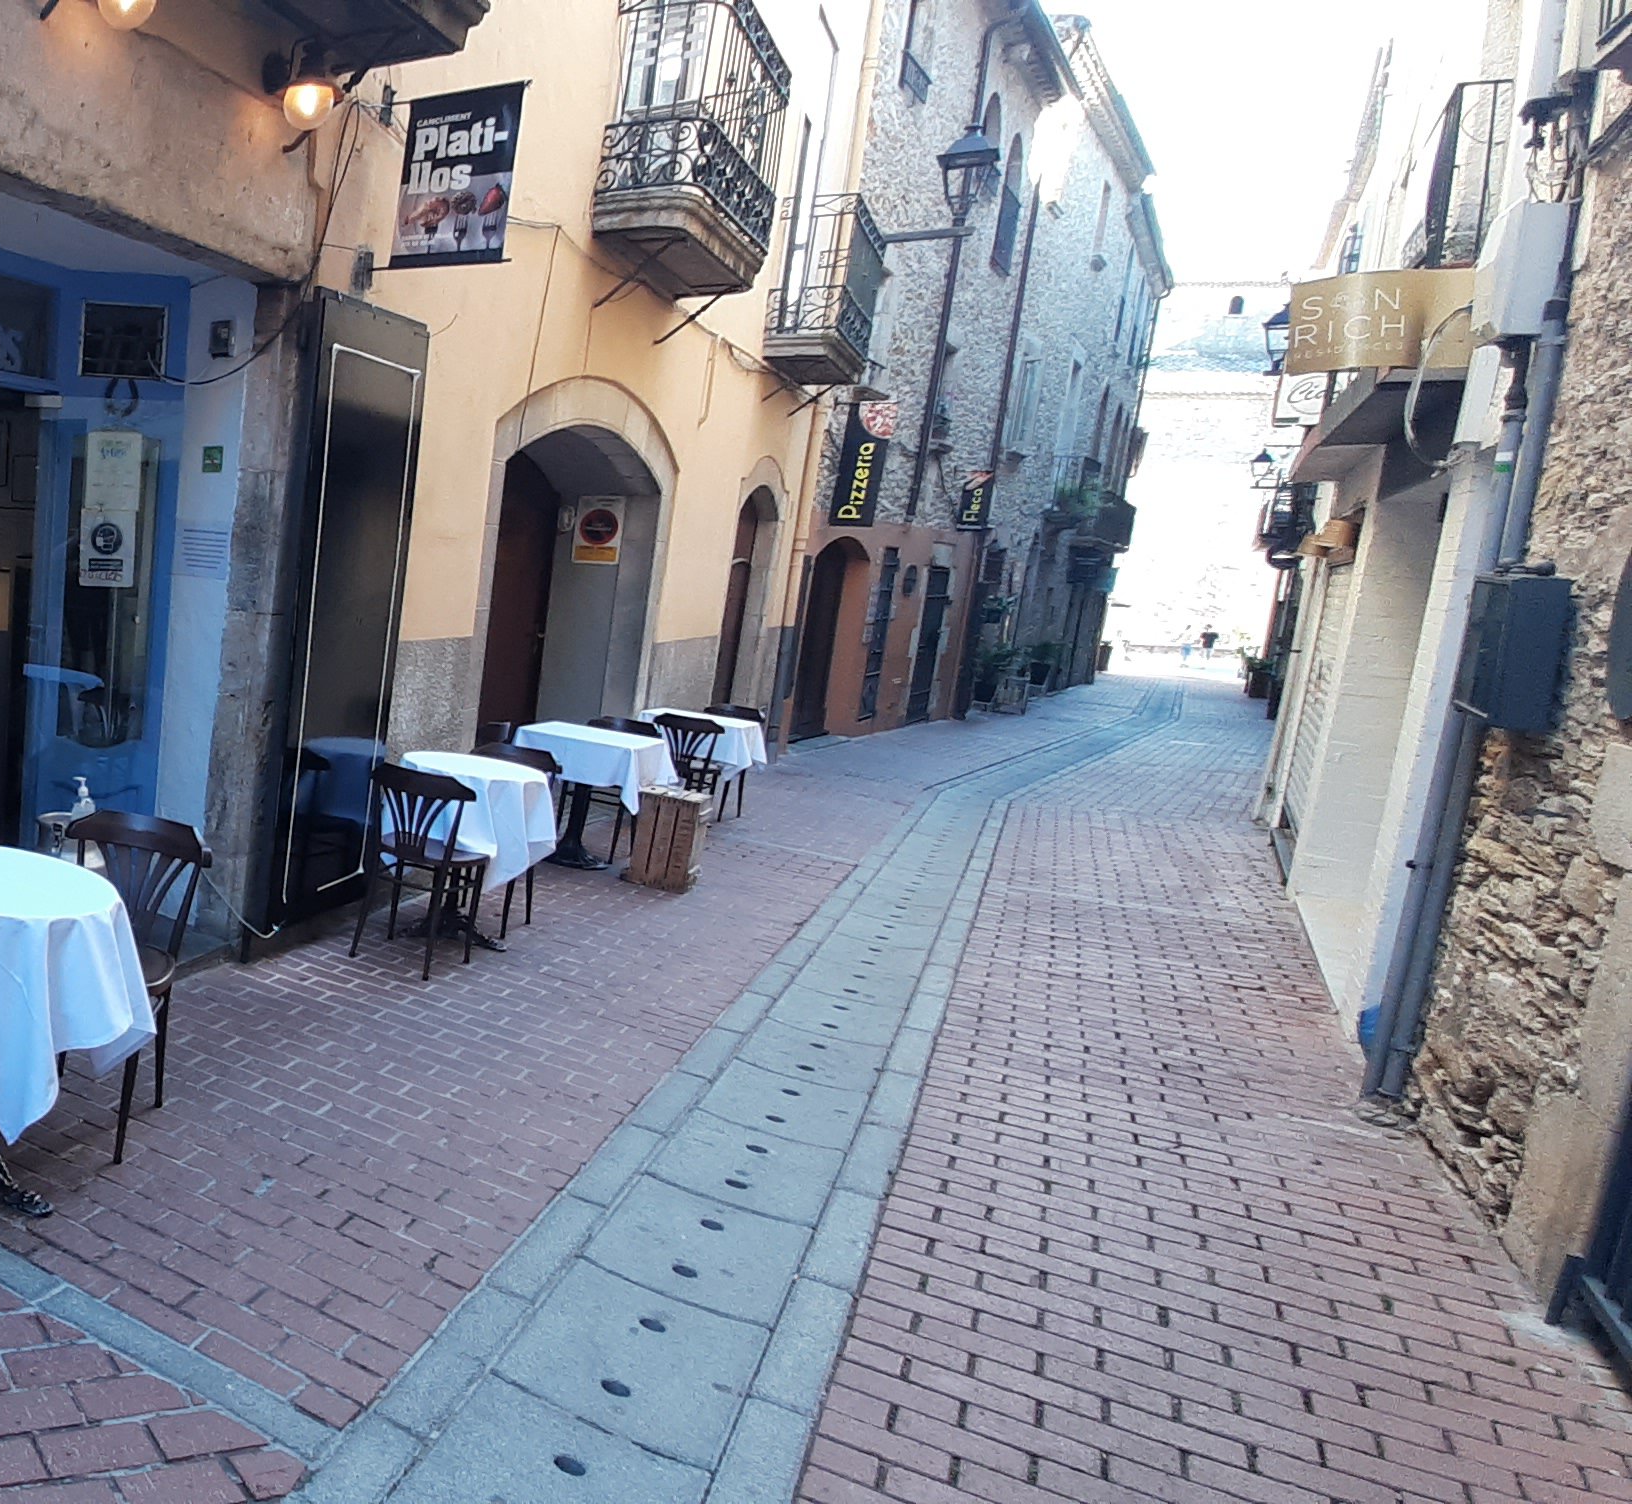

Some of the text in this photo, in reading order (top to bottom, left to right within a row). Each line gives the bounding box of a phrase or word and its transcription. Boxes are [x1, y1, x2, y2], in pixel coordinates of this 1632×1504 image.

[416, 111, 473, 127] CANCLIMENT
[411, 116, 510, 162] Plati-
[406, 162, 474, 196] llos
[1293, 314, 1406, 348] RICH
[836, 441, 877, 520] Pizzeria
[962, 487, 984, 523] Fleca
